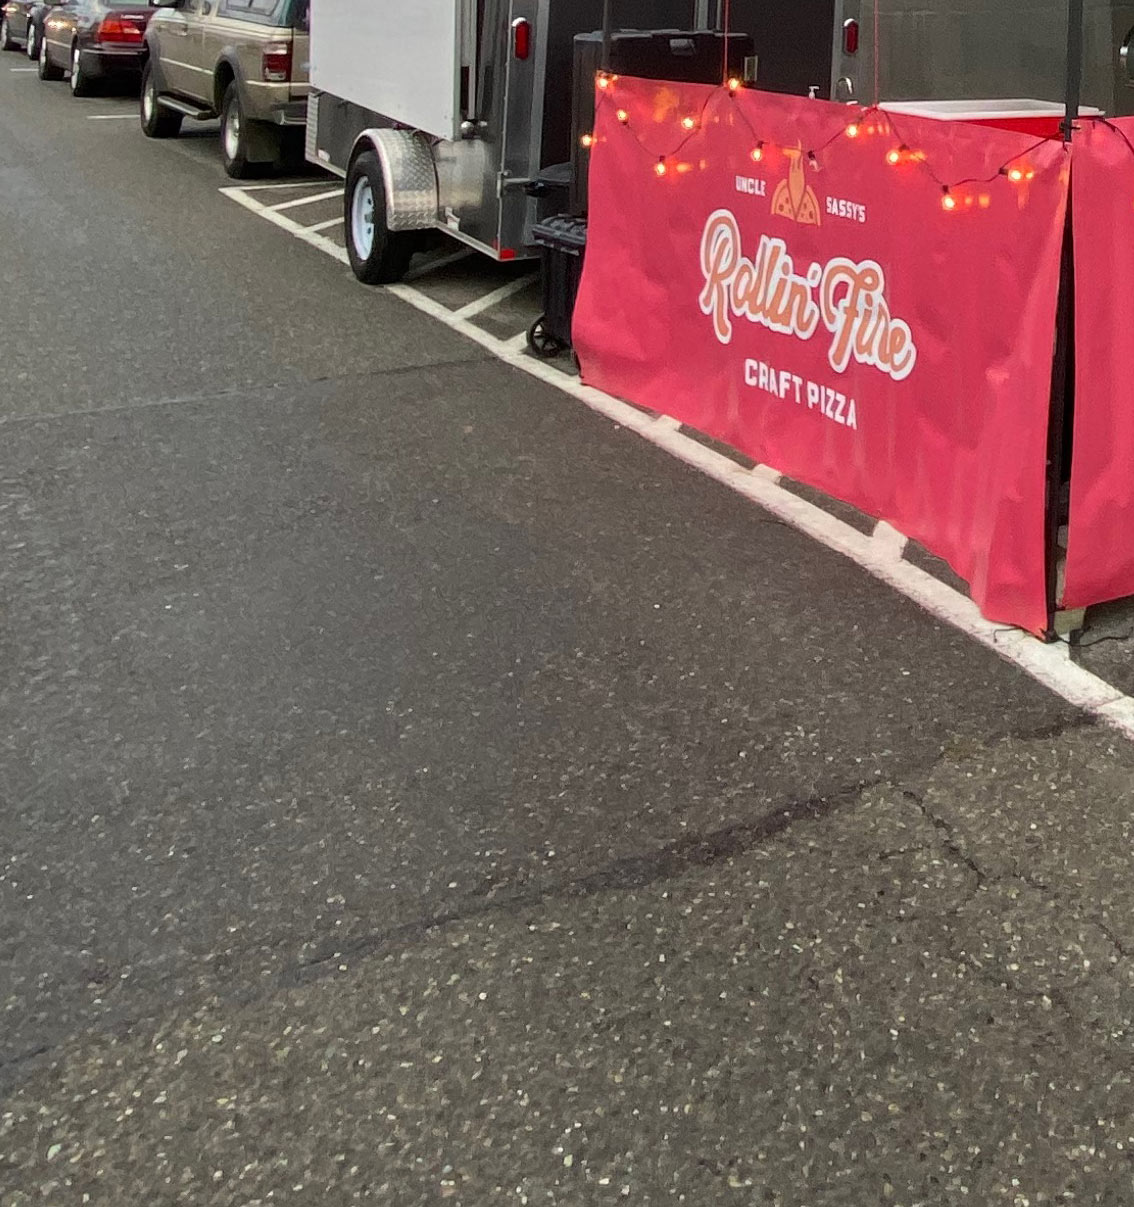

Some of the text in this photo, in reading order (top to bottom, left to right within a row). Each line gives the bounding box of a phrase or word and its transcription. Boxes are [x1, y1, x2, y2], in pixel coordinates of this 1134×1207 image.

[735, 175, 866, 223] UNCLE SASSY'S
[820, 256, 916, 380] Fire
[744, 358, 857, 430] CRAFT PIZZA
